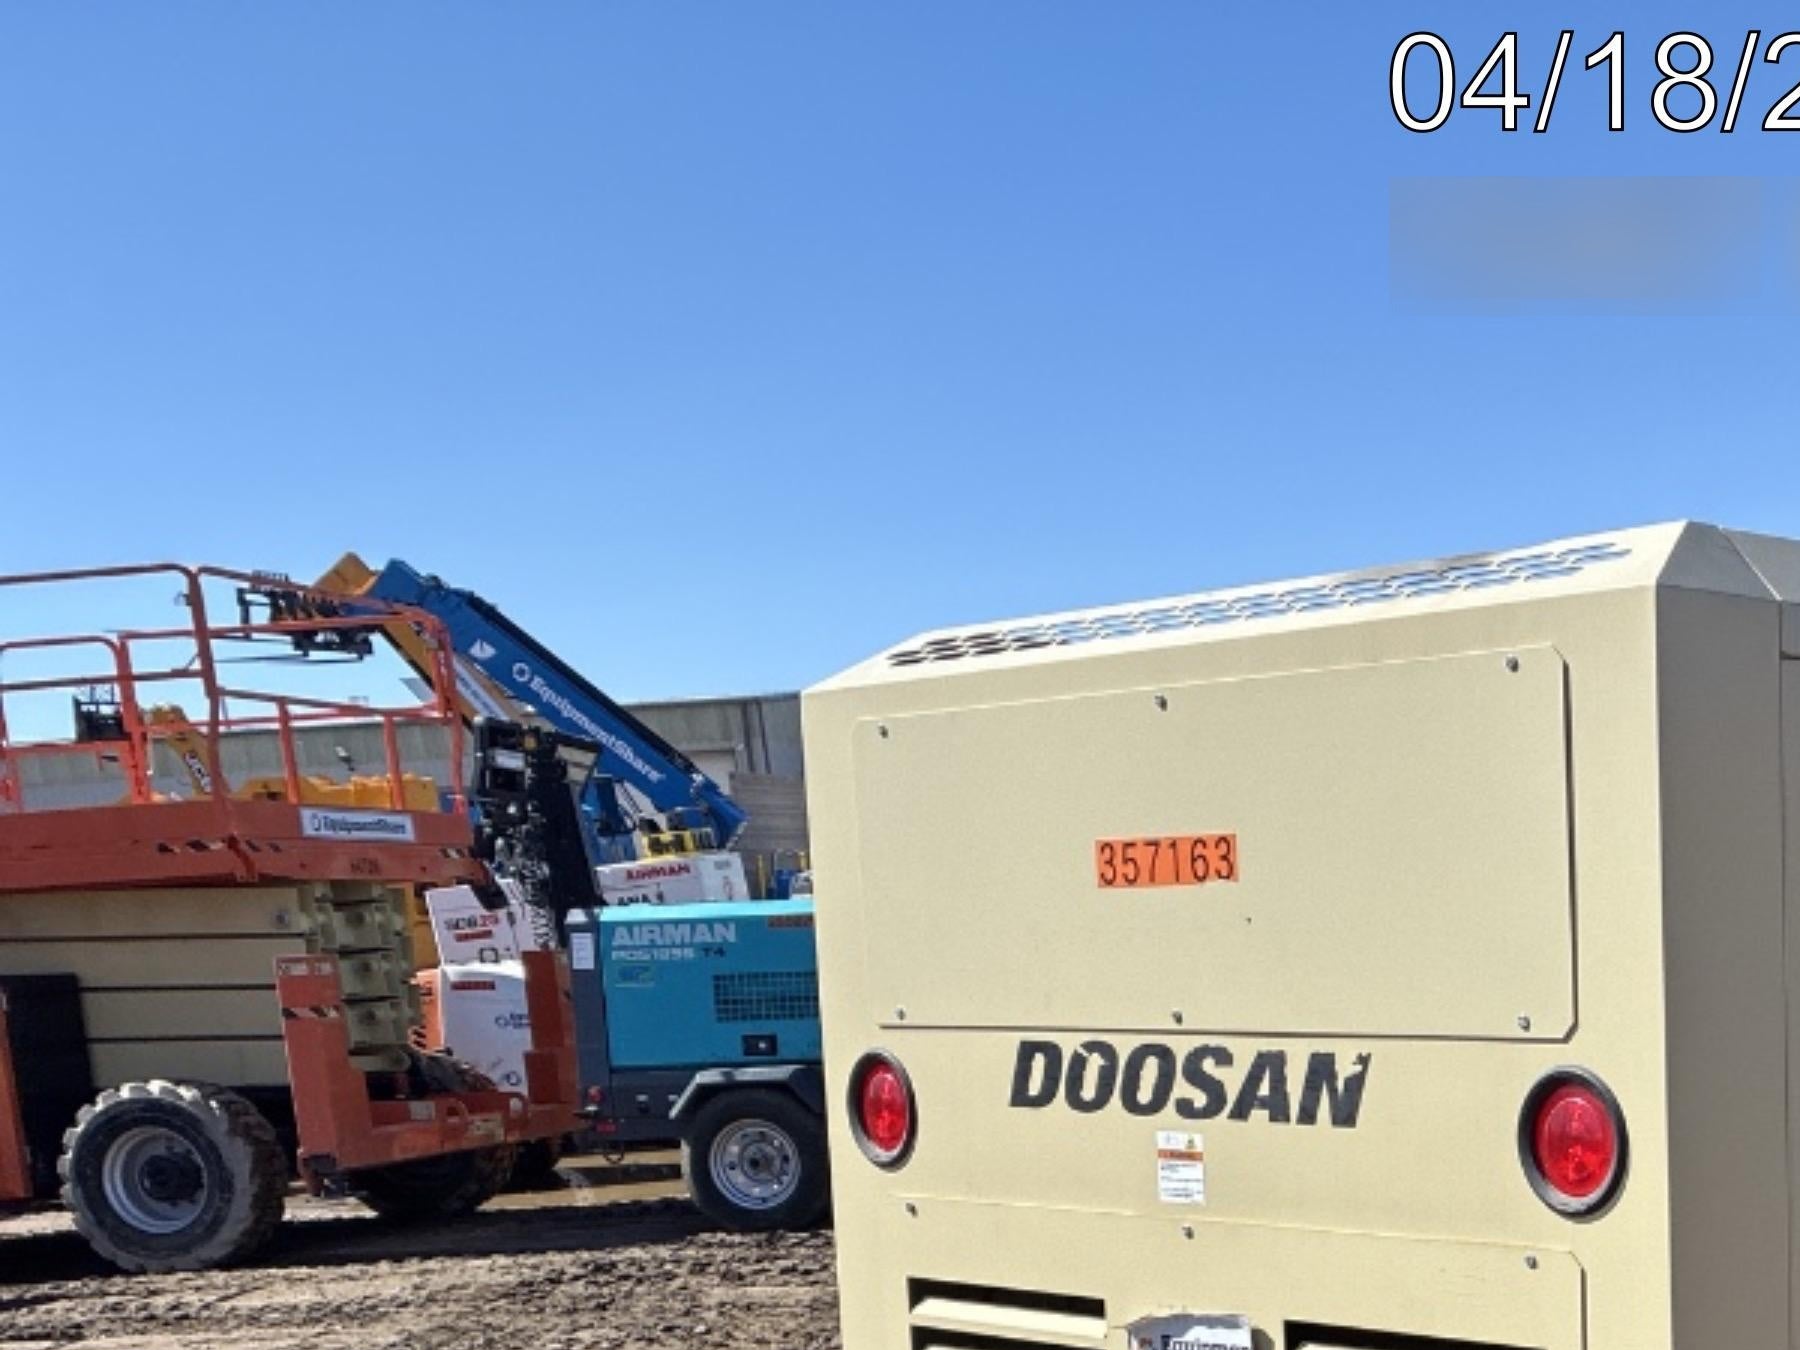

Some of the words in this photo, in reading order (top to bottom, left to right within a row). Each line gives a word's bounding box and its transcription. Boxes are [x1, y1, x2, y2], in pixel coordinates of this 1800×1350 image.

[529, 673, 665, 783] EquipmentShare
[1099, 836, 1235, 886] 357163
[611, 922, 737, 947] AIRMAN
[1008, 1039, 1372, 1129] DOOSAN
